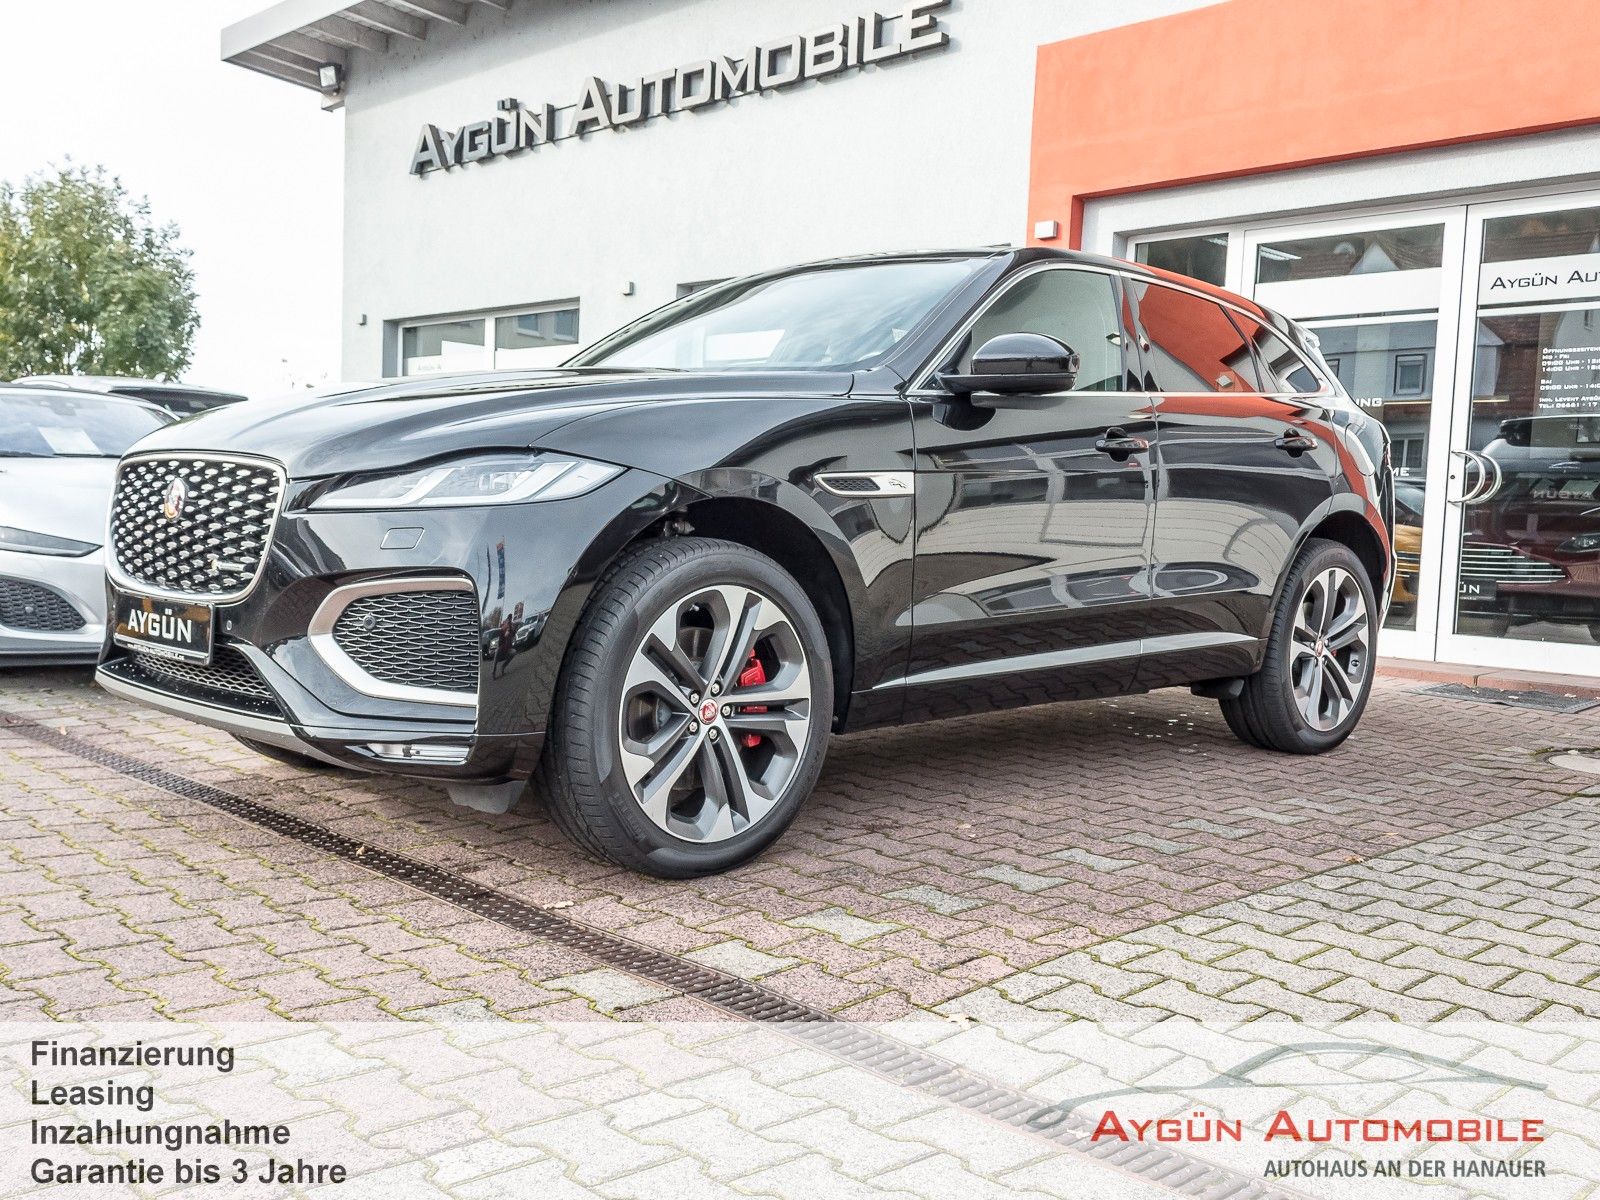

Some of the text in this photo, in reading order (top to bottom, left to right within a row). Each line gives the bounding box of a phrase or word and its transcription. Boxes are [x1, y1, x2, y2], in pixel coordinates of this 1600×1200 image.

[409, 0, 951, 176] AYGÜN AUTOMOBILE
[1490, 270, 1600, 290] AYGÜN AU
[127, 608, 192, 643] AYGÜN
